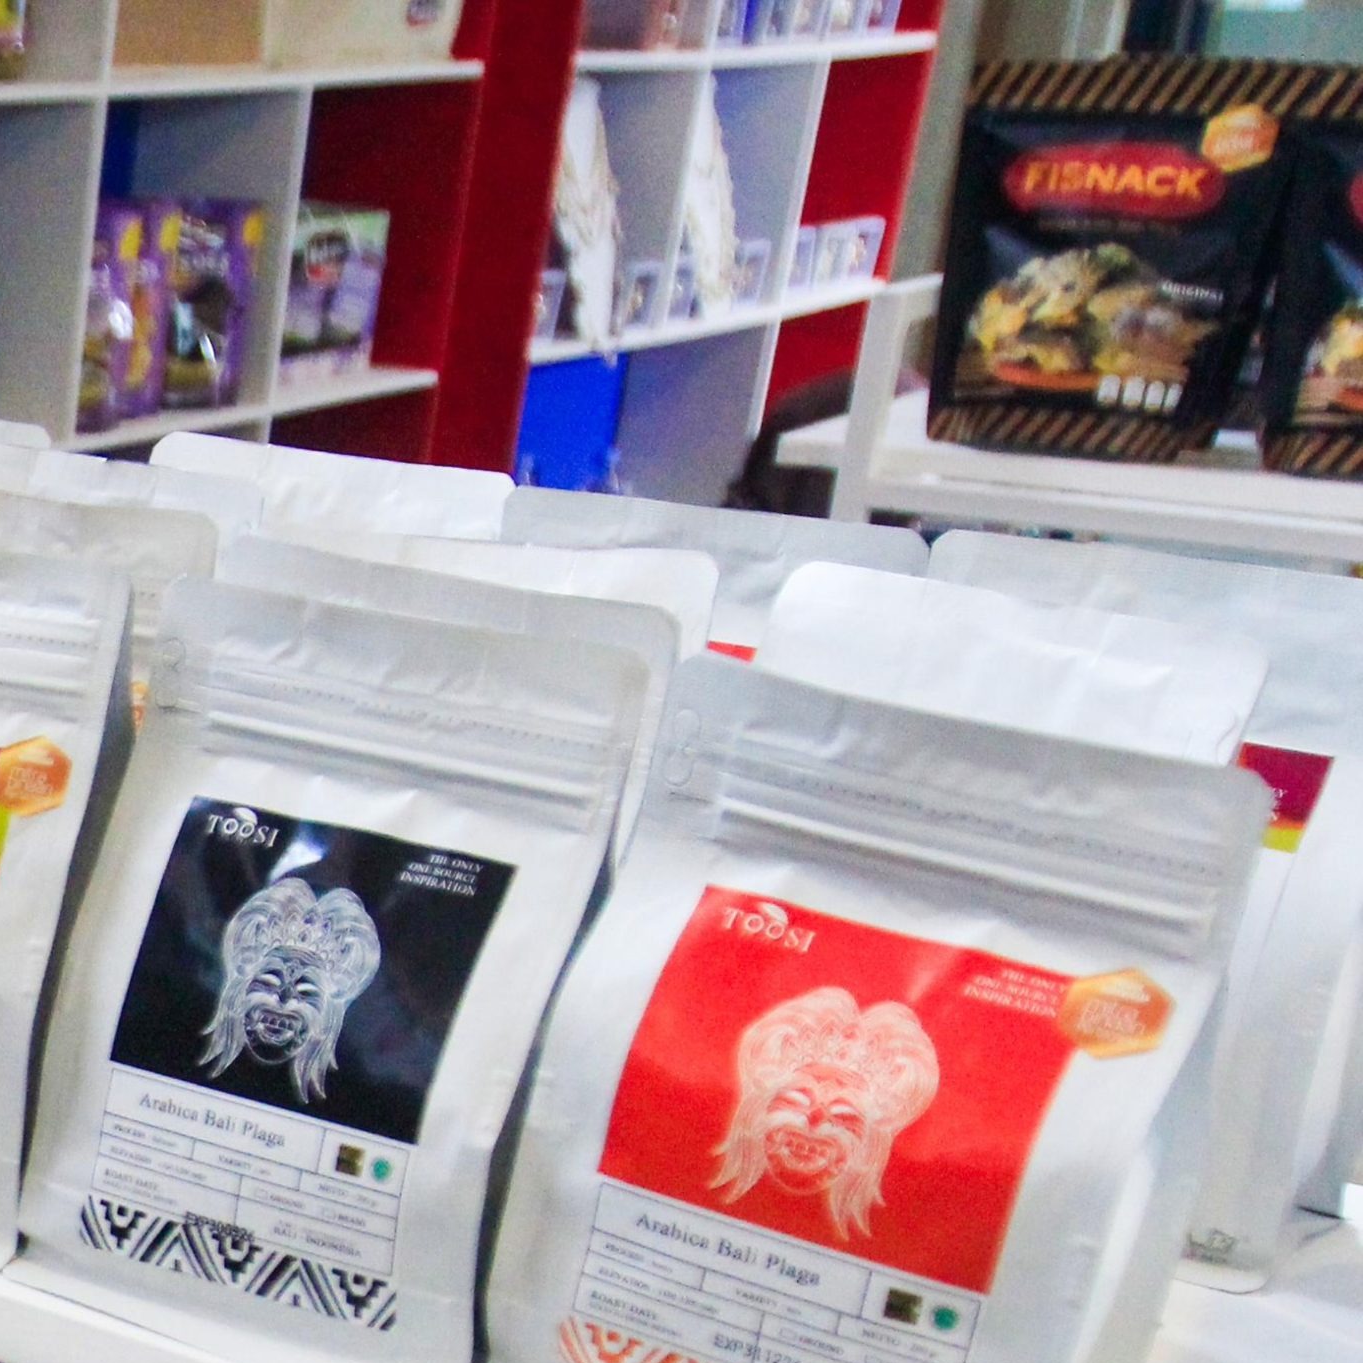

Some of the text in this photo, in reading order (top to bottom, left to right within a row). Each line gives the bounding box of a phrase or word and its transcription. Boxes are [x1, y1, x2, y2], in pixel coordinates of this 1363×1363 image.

[1025, 161, 1207, 201] FISNACK
[207, 810, 281, 848] TOOSI
[399, 871, 476, 896] INSPIRATION
[452, 859, 483, 872] ONLY
[722, 905, 817, 953] TOOSI
[139, 1093, 286, 1148] Arabica Bali Plaga
[636, 1213, 821, 1287] Arabica Bali Plaga
